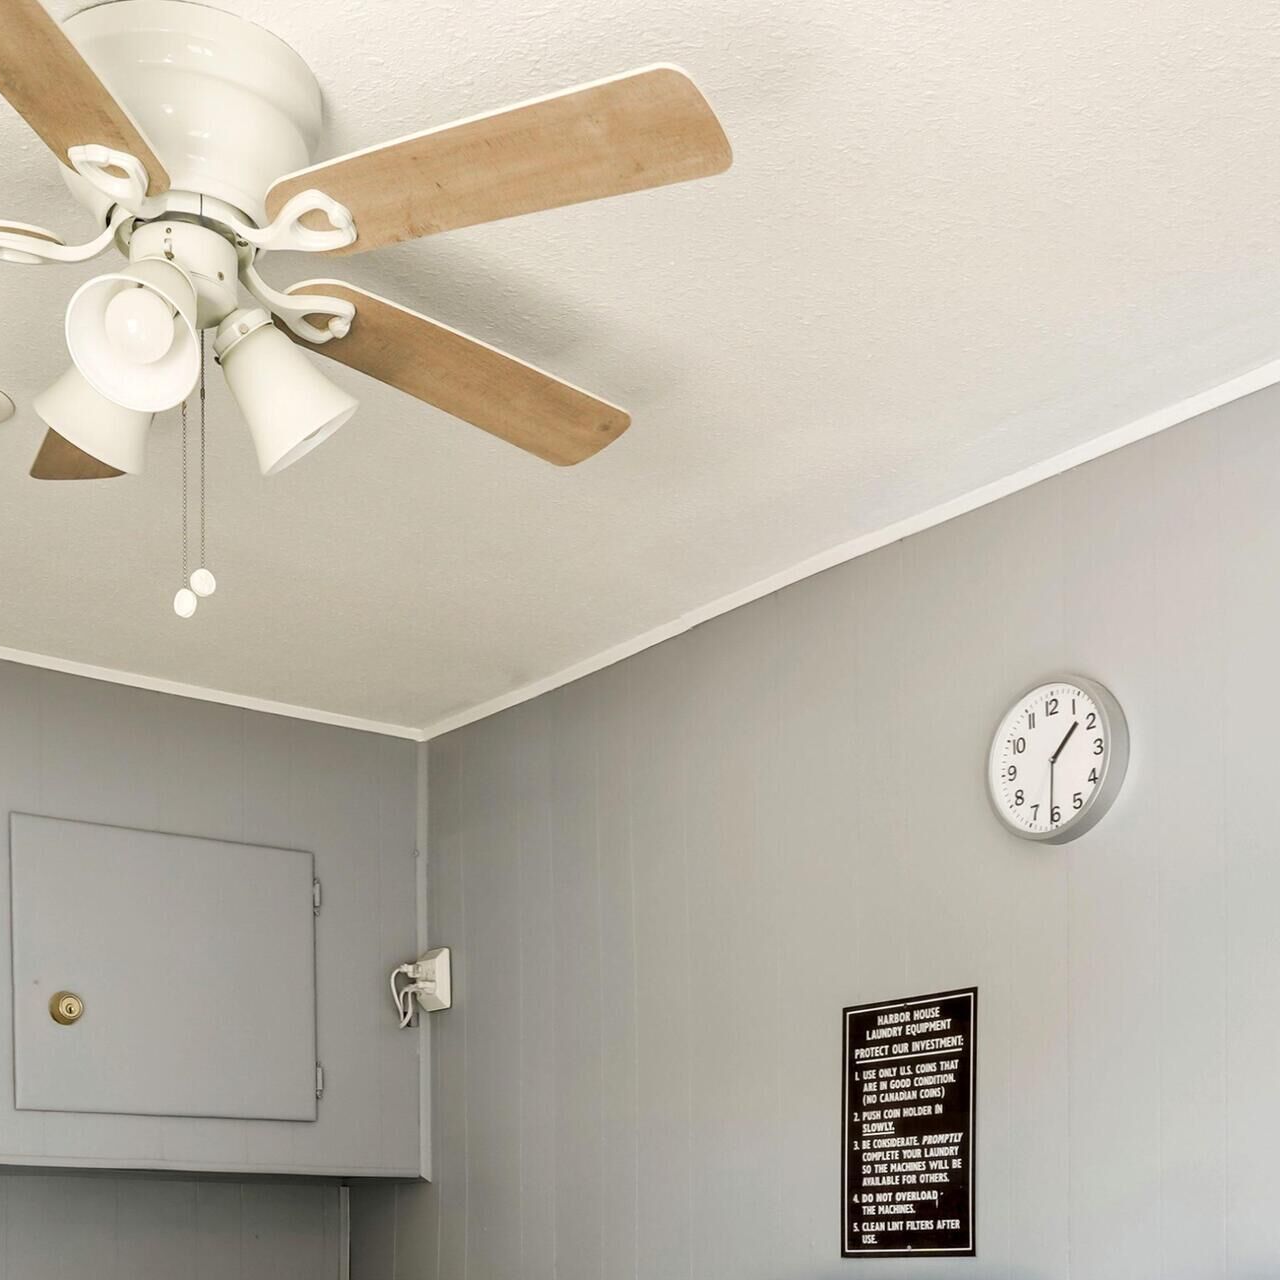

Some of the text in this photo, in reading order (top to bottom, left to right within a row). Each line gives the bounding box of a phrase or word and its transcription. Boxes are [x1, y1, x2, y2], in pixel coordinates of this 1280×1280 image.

[1045, 699, 1058, 717] 12
[1028, 713, 1035, 729] 11
[1086, 713, 1096, 730] 2
[1013, 737, 1026, 754] 10
[1093, 738, 1103, 755] 3
[1008, 766, 1016, 781] 9
[1088, 768, 1098, 784] 4
[1015, 789, 1024, 806] 8
[1073, 792, 1083, 809] 5
[1031, 804, 1039, 821] 7
[1051, 806, 1061, 822] 6
[877, 1007, 940, 1026] HARBOR HOUSE
[866, 1019, 951, 1040] LAUNDRY EQUIPMENT
[854, 1035, 964, 1059] PROTECT OUR INVESTMENT:
[863, 1070, 876, 1080] USE
[879, 1067, 897, 1078] ONLY
[900, 1065, 913, 1075] U.S.
[915, 1063, 937, 1074] COINS
[940, 1059, 959, 1071] THAT
[863, 1073, 956, 1092] ARE IN GOOD CONDITION.
[863, 1086, 945, 1106] (NO CANADIAN COINS)
[862, 1110, 881, 1120] PUSH
[883, 1108, 900, 1119] COIN
[903, 1105, 932, 1117] HOLDER
[935, 1103, 943, 1114] IN
[862, 1122, 895, 1133] SLOWLY.
[862, 1140, 870, 1149] BE
[922, 1132, 963, 1145] PROMPTLY
[862, 1146, 959, 1161] COMPLETE YOUR LAUNDRY
[862, 1159, 962, 1174] SO THE MACHINES WILL BE
[862, 1173, 949, 1186] AVAILABLE FOR OTHERS.
[862, 1194, 873, 1203] DO
[876, 1193, 893, 1202] NOT
[896, 1191, 938, 1201] OVERLOAD
[862, 1204, 916, 1215] THE MACHINES.
[862, 1222, 885, 1231] CLEAN
[887, 1221, 904, 1231] LINT
[906, 1220, 934, 1230] FILTERS
[936, 1220, 960, 1229] AFTER
[862, 1235, 878, 1244] USE.
